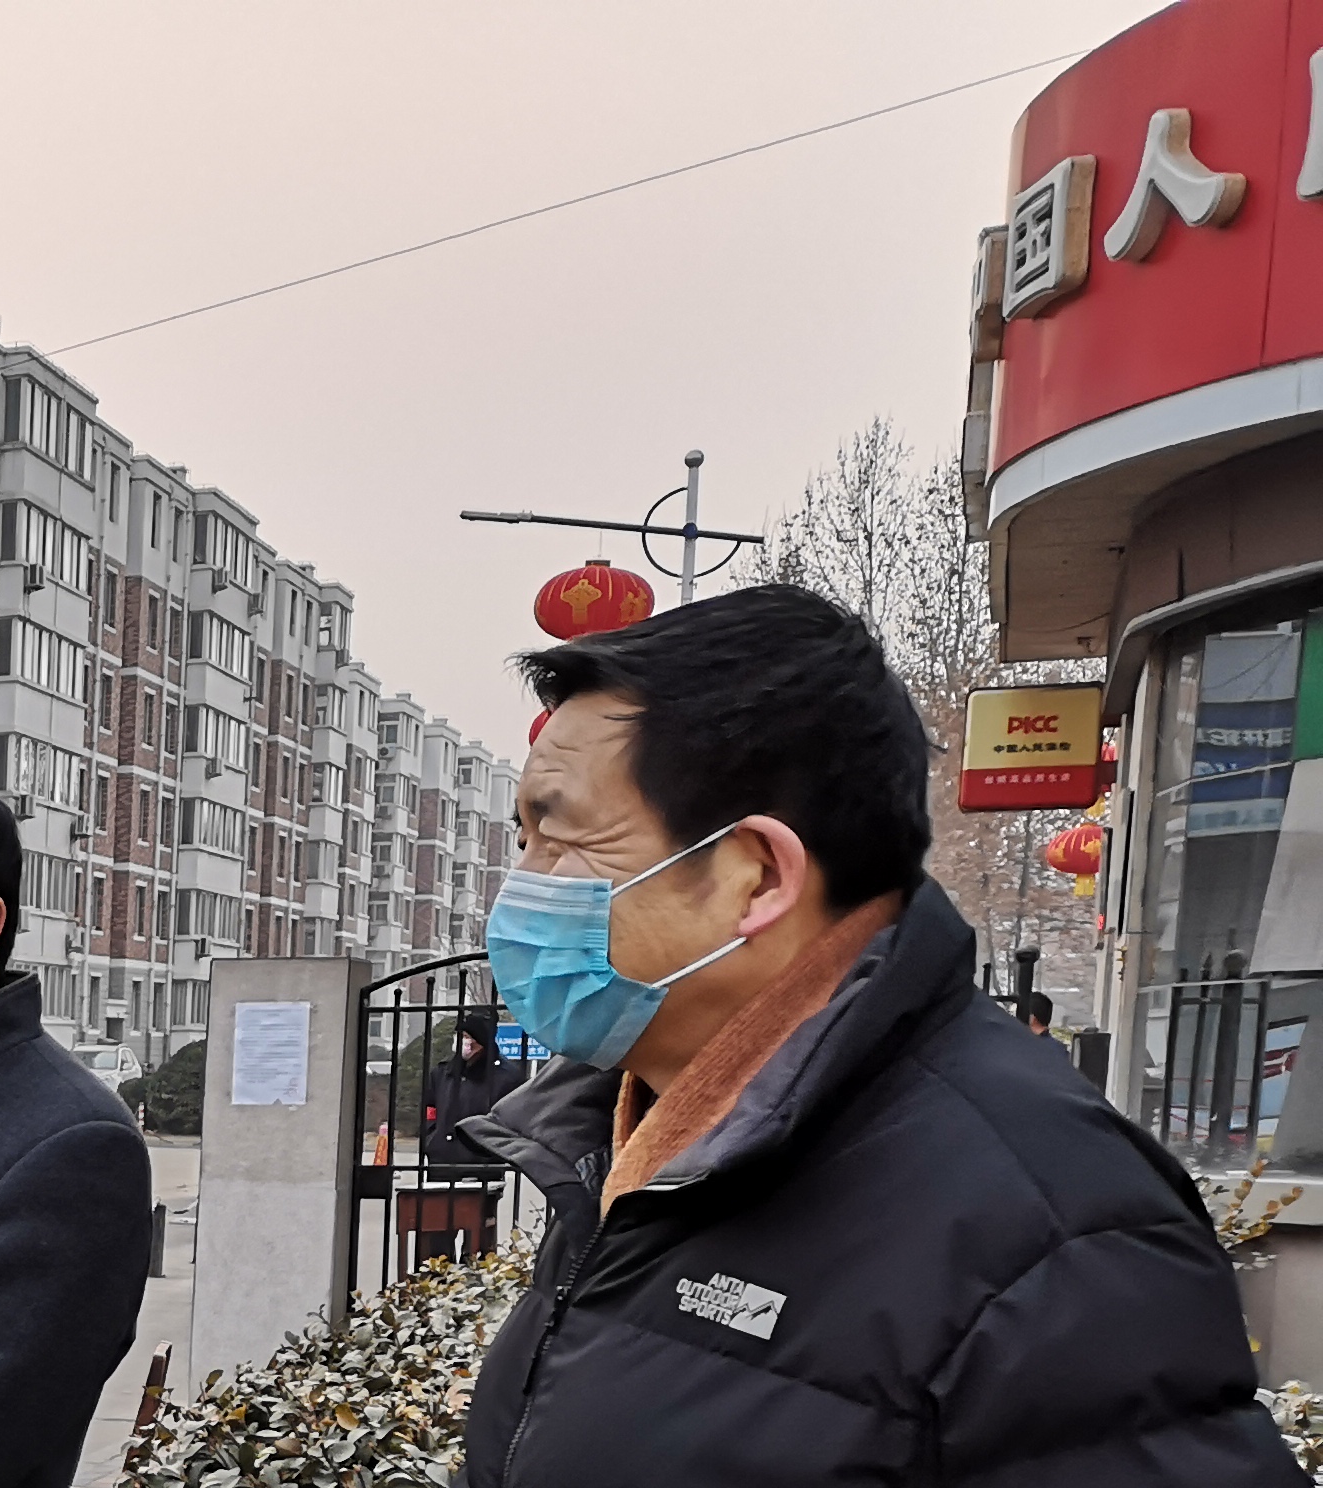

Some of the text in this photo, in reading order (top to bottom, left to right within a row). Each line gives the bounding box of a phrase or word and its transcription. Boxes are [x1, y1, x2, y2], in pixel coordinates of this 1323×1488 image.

[1007, 715, 1059, 734] PICC
[994, 741, 1072, 754] 中国人民保险
[676, 1278, 740, 1310] OUTDOOR
[708, 1272, 745, 1296] ANTA
[678, 1295, 733, 1325] SPORTS
